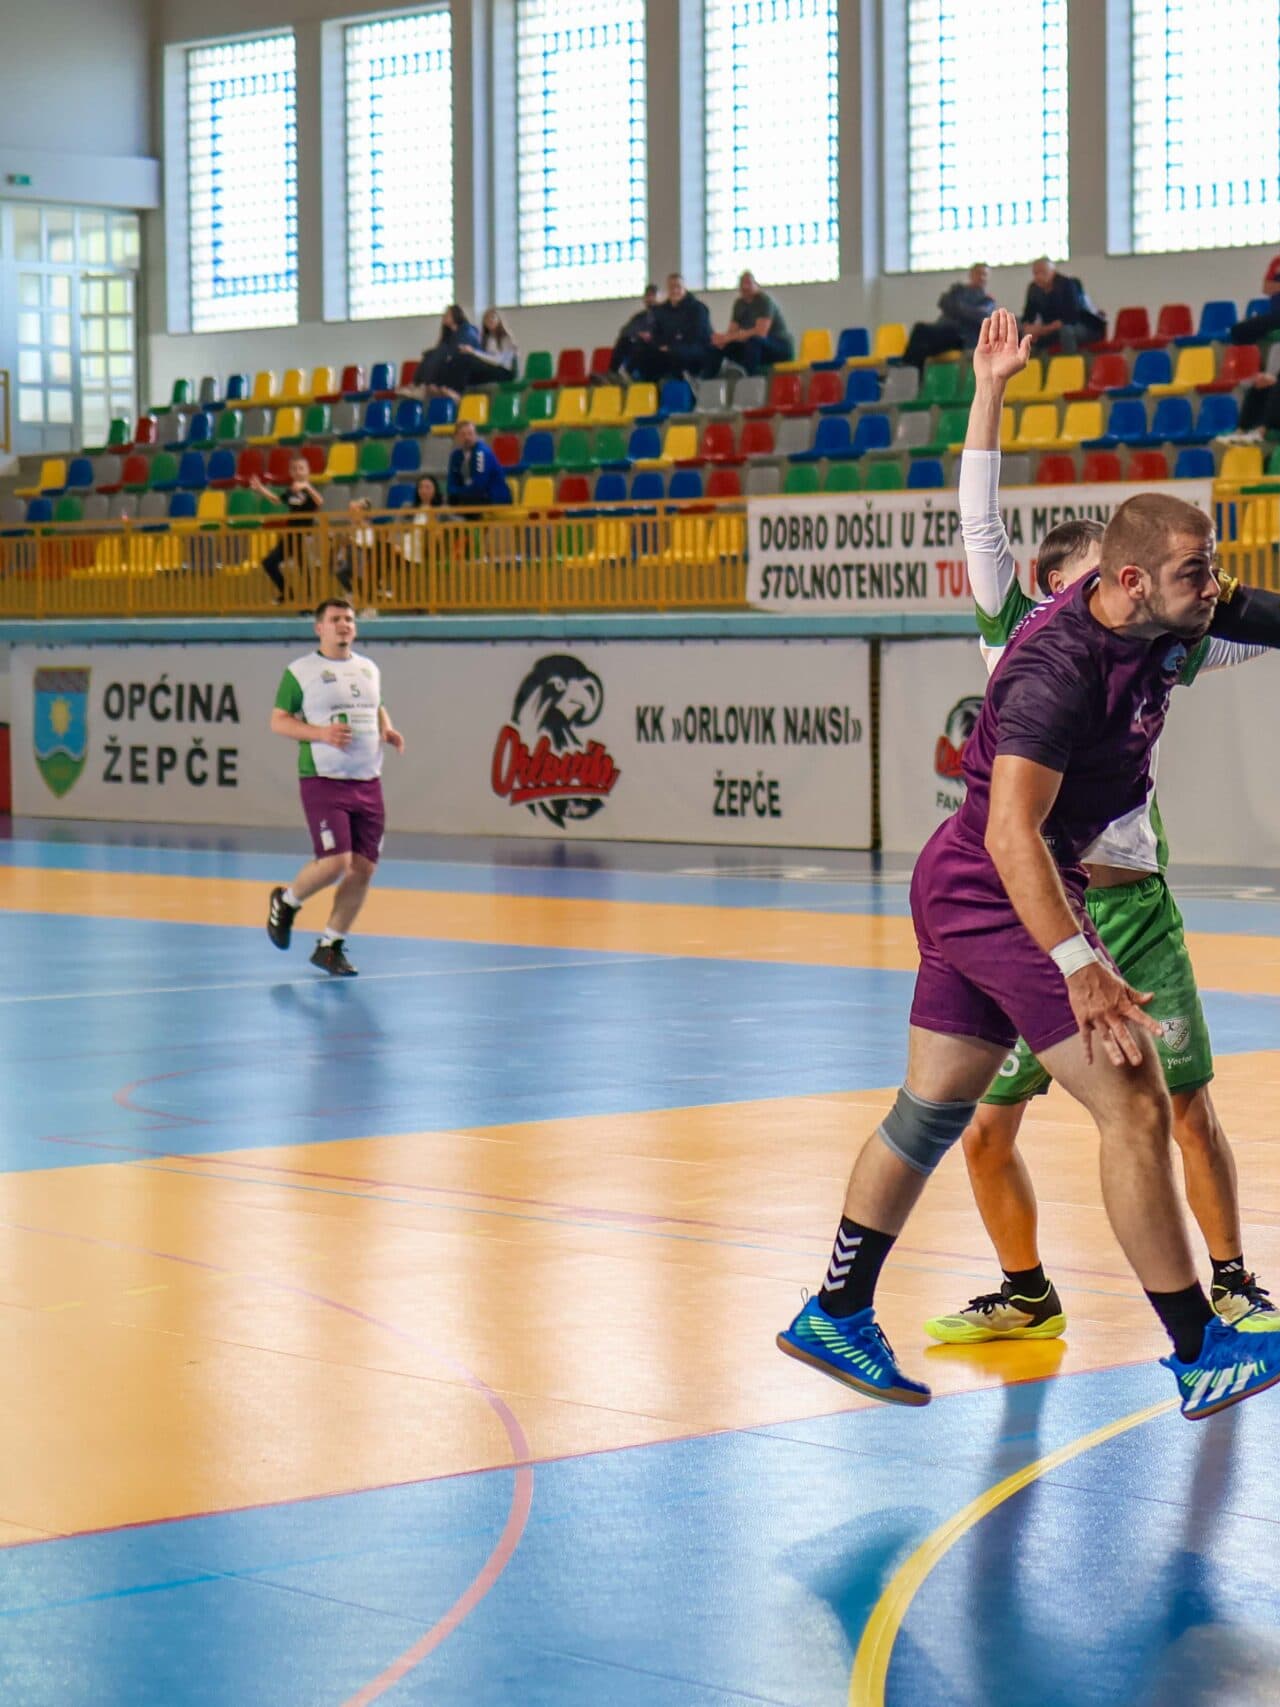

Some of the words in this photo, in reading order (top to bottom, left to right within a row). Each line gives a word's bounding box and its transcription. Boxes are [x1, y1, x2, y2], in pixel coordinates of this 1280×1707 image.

[759, 515, 828, 551] DOBRO
[836, 500, 893, 549] DOŠLI
[901, 511, 915, 546] U
[922, 499, 960, 548] ŽEP
[760, 561, 927, 600] STOLNOTENISKI
[103, 673, 240, 724] OPĆINA
[635, 705, 665, 743] KK
[102, 735, 239, 787] ŽEPČE
[713, 770, 783, 818] ŽEPČE
